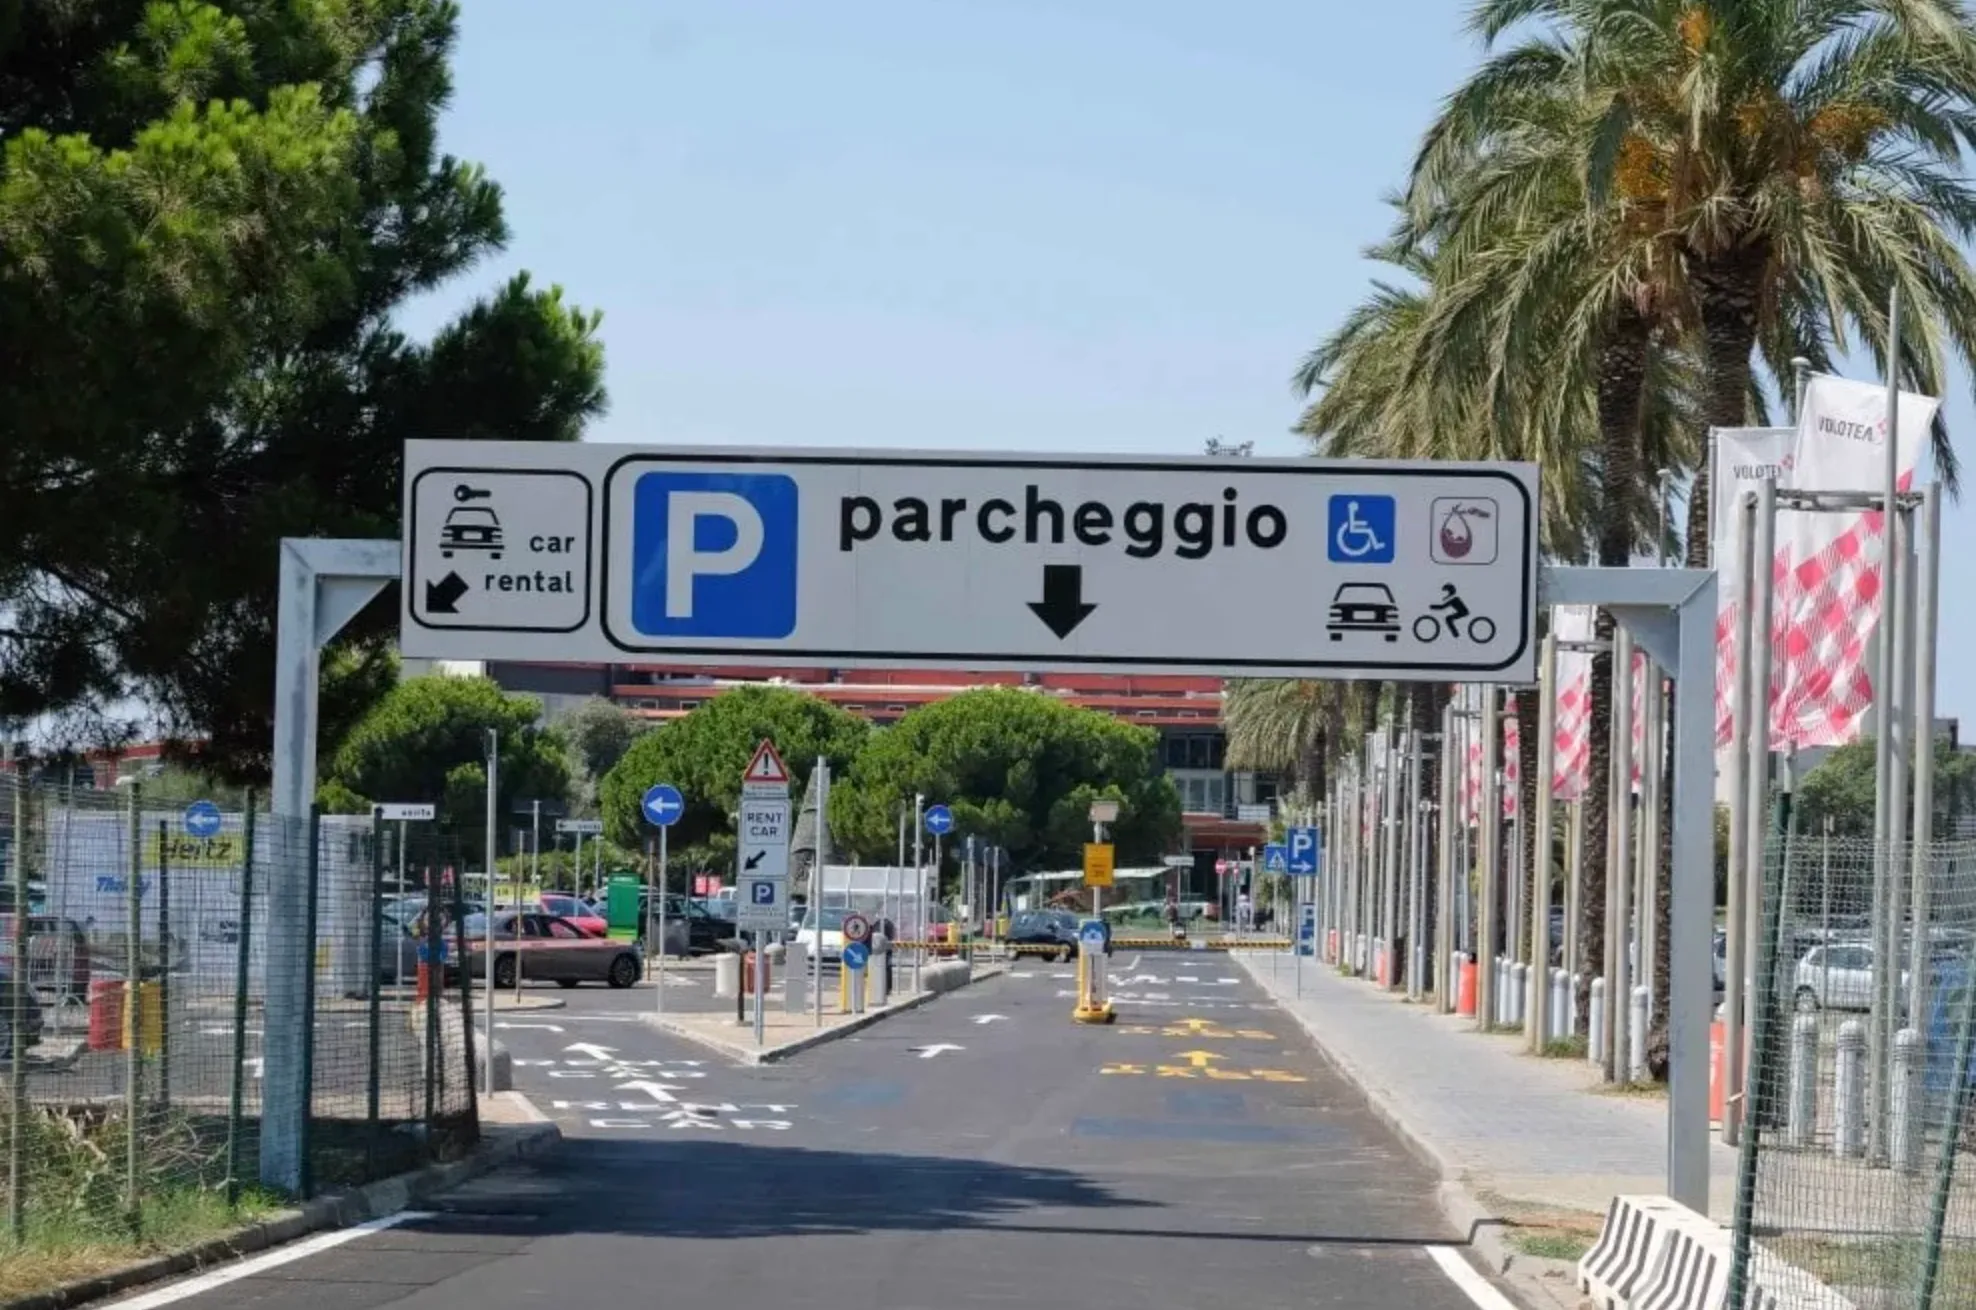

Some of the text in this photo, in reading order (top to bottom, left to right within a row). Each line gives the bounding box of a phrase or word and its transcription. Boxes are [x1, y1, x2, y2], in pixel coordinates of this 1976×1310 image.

[839, 484, 1288, 559] parcheggio
[529, 533, 575, 554] car
[666, 490, 764, 618] P
[484, 570, 574, 594] rental
[747, 812, 783, 824] RENT
[751, 826, 778, 837] CAR
[1293, 834, 1313, 859] P
[755, 884, 771, 904] P
